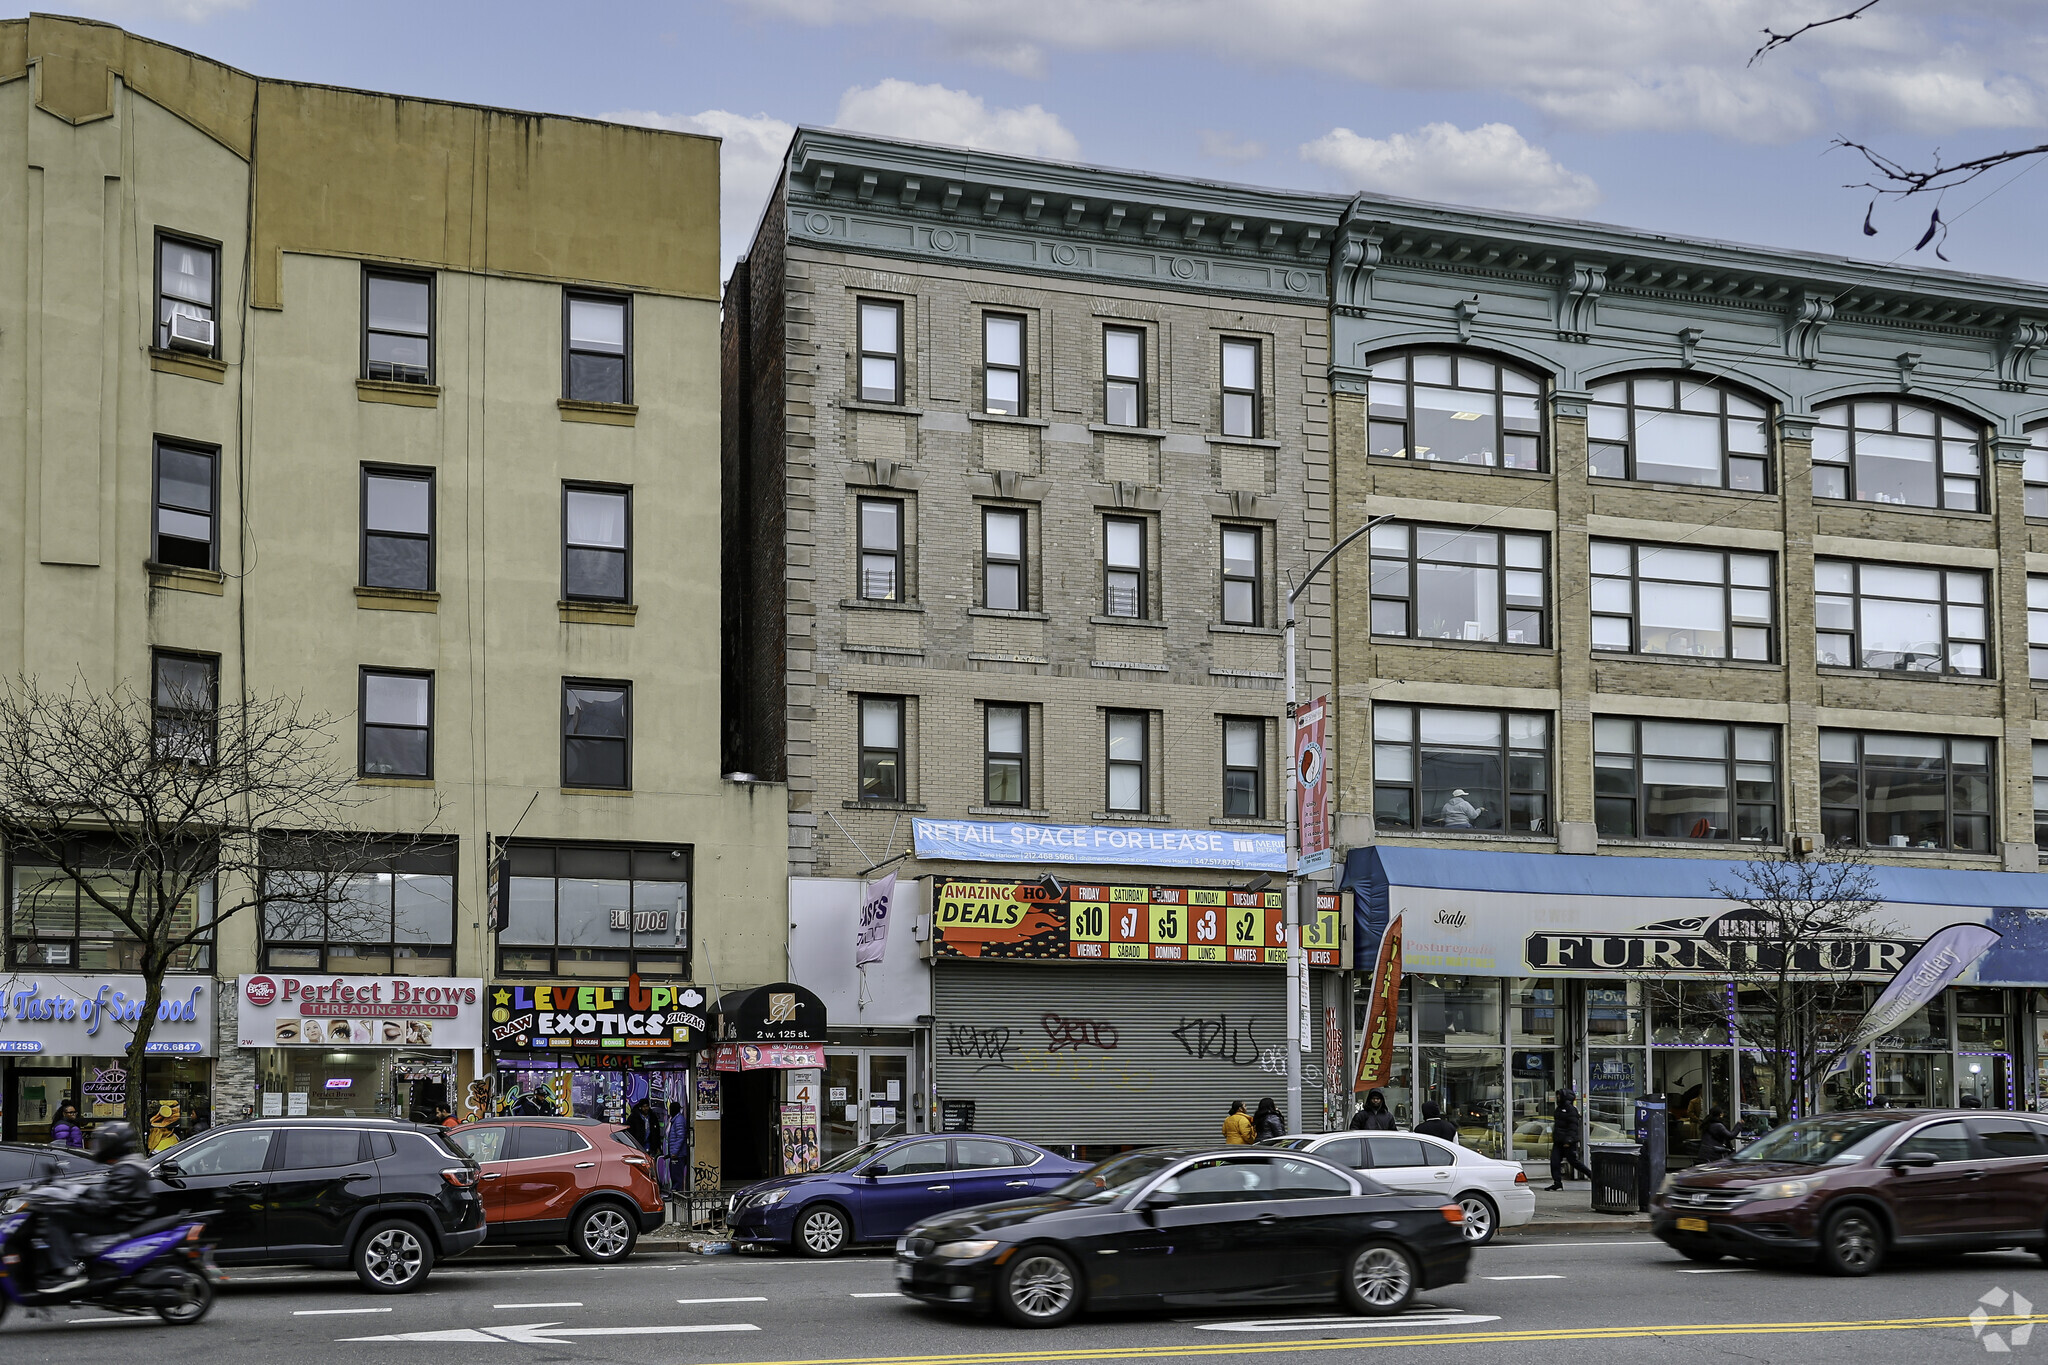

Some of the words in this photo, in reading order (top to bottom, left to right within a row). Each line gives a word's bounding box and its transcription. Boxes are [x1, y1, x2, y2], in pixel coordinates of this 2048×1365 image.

[918, 822, 1003, 844] RETAIL
[1010, 827, 1087, 847] SPACE
[1094, 830, 1143, 849] FOR
[1151, 832, 1224, 851] LEASE
[1023, 852, 1075, 861] 212.468.5966
[944, 885, 1011, 900] AMAZING
[1023, 887, 1048, 900] HO
[1079, 887, 1100, 900] FRIDAY
[1114, 889, 1144, 902] SATURDAY
[1194, 892, 1219, 904] MONDAY
[1232, 892, 1258, 906] TUESDAY
[1317, 896, 1335, 909] RSDAY
[942, 902, 1020, 924] DEALS
[1433, 909, 1467, 928] Sealy
[1076, 907, 1103, 937] $10
[1120, 908, 1138, 938] $7
[1158, 910, 1178, 939] $5
[1196, 910, 1217, 941] $3
[1236, 911, 1254, 942] $2
[1718, 919, 1780, 938] HARLEM
[1309, 915, 1333, 944] $1
[1077, 944, 1102, 957] VIERNES
[1155, 946, 1182, 959] DOMINGO
[1198, 948, 1216, 960] LUNES
[1233, 948, 1257, 962] MARTES
[1310, 951, 1331, 964] JUEVES
[1539, 935, 1907, 972] FURNITUR
[1405, 954, 1442, 966] OUTLET
[1913, 946, 1961, 988] Gallery
[281, 978, 382, 1002] Perfect
[391, 980, 476, 1004] Brows
[514, 986, 615, 1011] LEVEL
[628, 974, 679, 1011] UP!
[13, 981, 75, 1020] Taste
[79, 984, 111, 1035] of
[109, 985, 202, 1021] Seaood
[310, 1004, 397, 1015] THREADING
[401, 1005, 450, 1016] SALON
[492, 1014, 532, 1041] RAW
[538, 1012, 666, 1035] EXOTICS
[756, 1031, 763, 1039] 2
[798, 1030, 810, 1038] st.
[145, 1043, 197, 1051] .476.6847
[575, 1053, 642, 1068] WELCOME
[1593, 1063, 1635, 1074] ASHLEY
[1592, 1073, 1635, 1081] FURNITURE
[796, 1086, 810, 1103] 4
[1640, 1109, 1647, 1120] P
